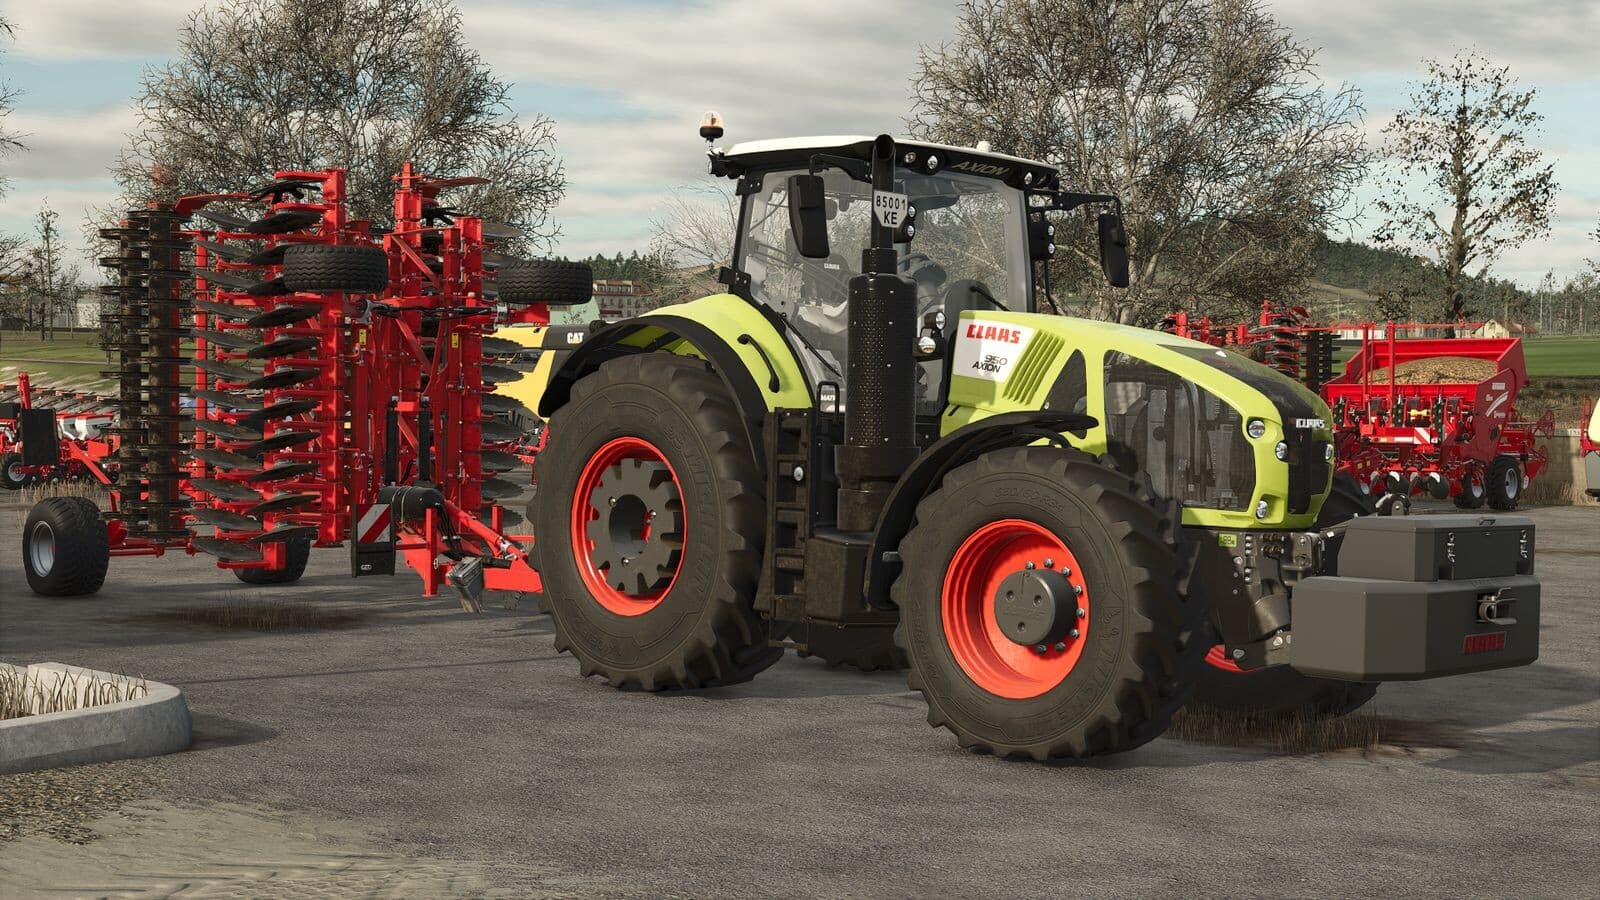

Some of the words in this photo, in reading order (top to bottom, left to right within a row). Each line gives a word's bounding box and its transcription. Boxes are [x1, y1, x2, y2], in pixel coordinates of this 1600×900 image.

[952, 161, 1009, 175] AXION
[875, 195, 906, 210] 85001
[883, 211, 897, 225] KE
[566, 332, 584, 344] CAT
[966, 324, 1021, 344] CLAAS
[972, 361, 1001, 373] AXION
[984, 355, 1008, 366] 950
